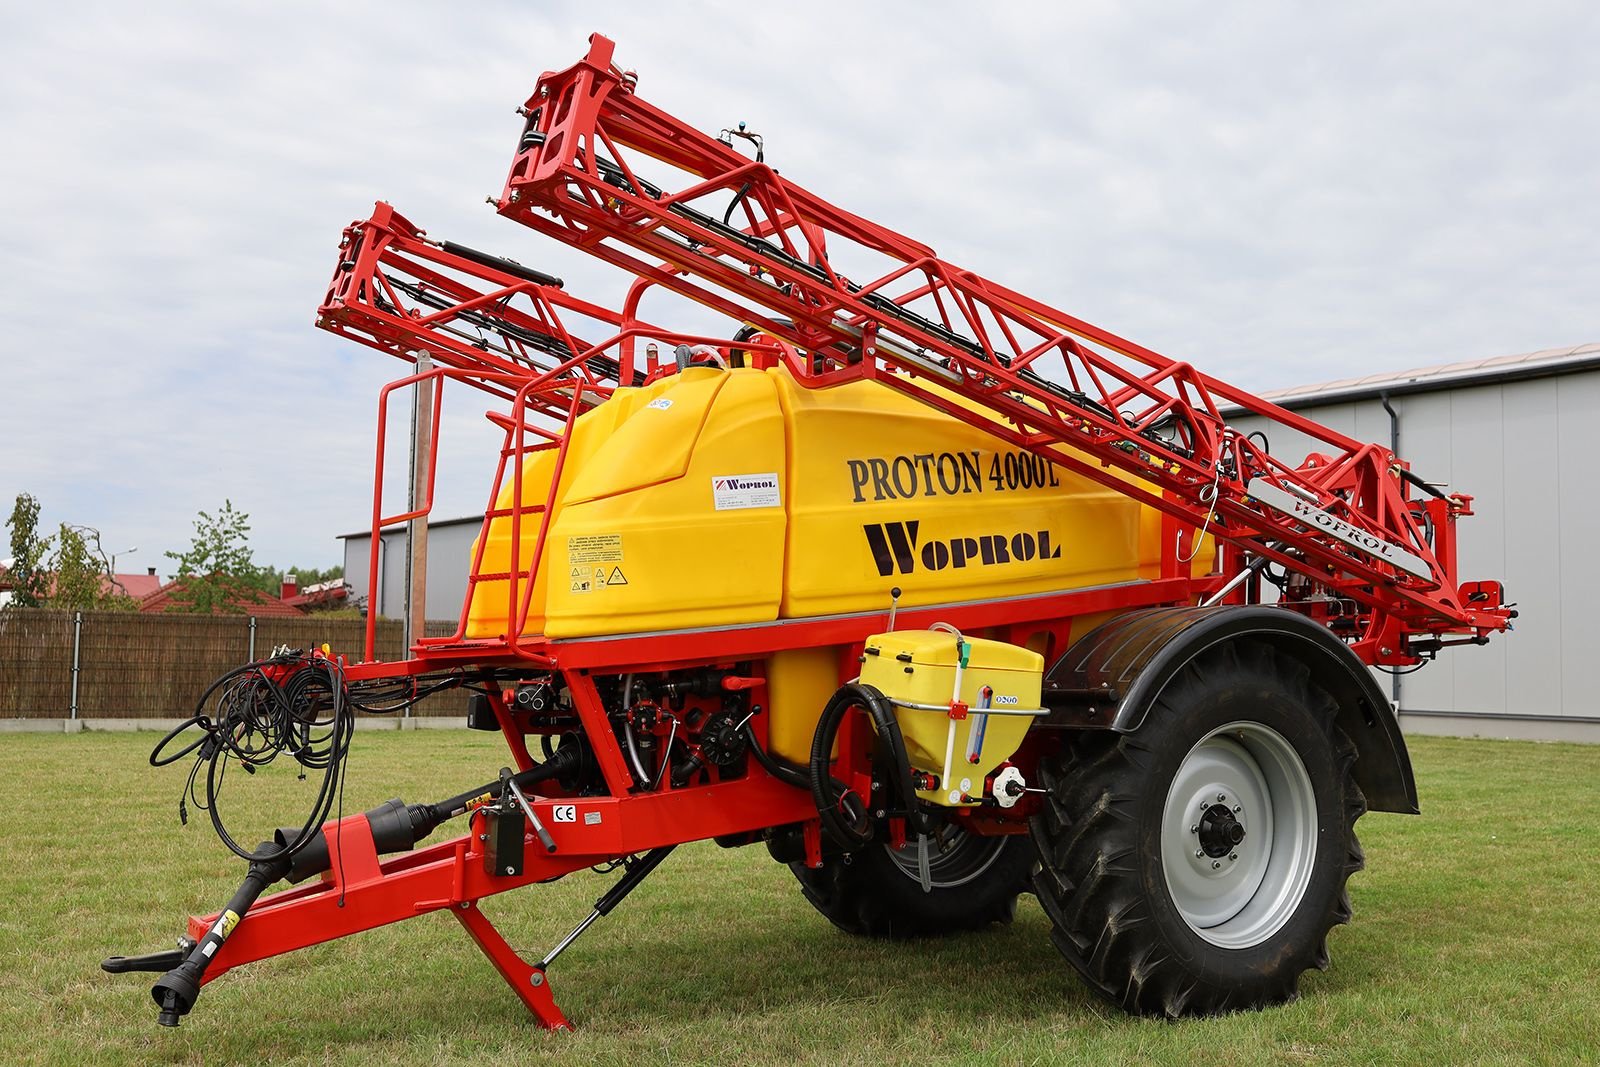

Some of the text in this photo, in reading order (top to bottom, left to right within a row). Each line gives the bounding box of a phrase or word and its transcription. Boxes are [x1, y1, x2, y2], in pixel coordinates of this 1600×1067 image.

[726, 479, 776, 490] WOPROL
[847, 451, 982, 503] PROTON
[863, 520, 1062, 577] WOPROL
[1293, 500, 1393, 557] WOPROL
[555, 806, 574, 821] CE
